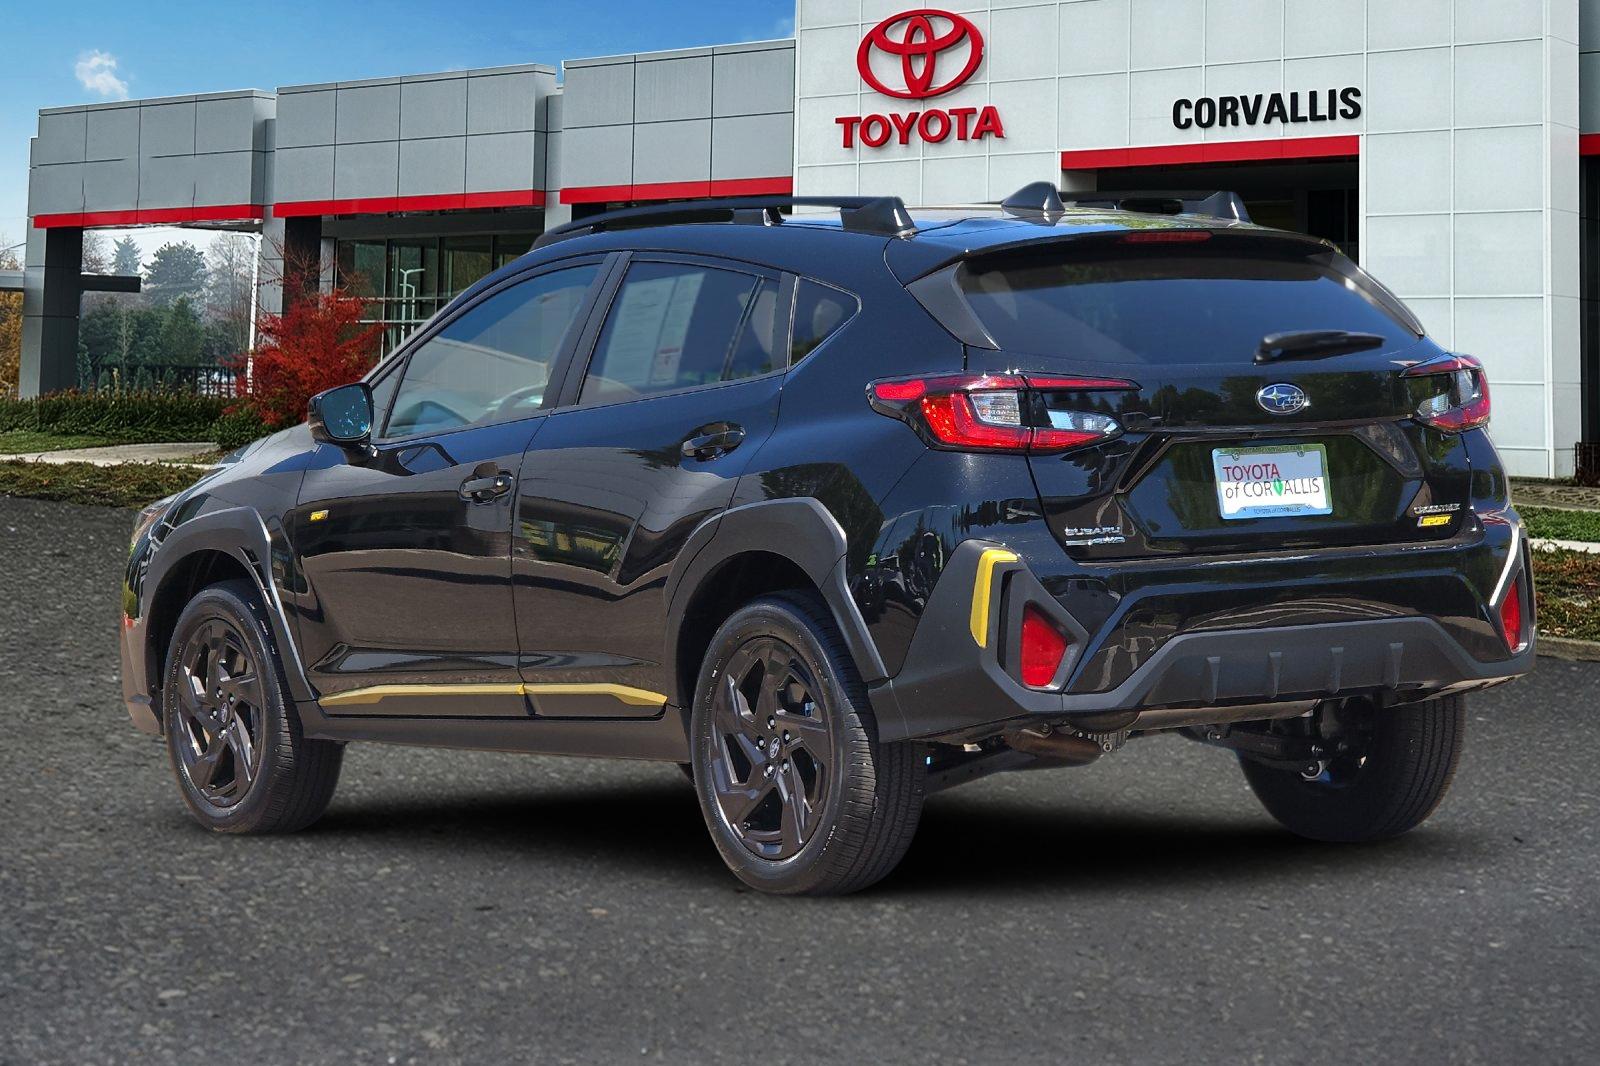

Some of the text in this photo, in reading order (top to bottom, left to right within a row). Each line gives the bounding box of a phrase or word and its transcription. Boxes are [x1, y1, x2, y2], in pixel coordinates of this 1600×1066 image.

[1172, 87, 1362, 130] CORVALLIS
[836, 105, 1006, 149] TOYOTA
[1222, 463, 1281, 482] TOYOTA
[1225, 482, 1239, 499] of
